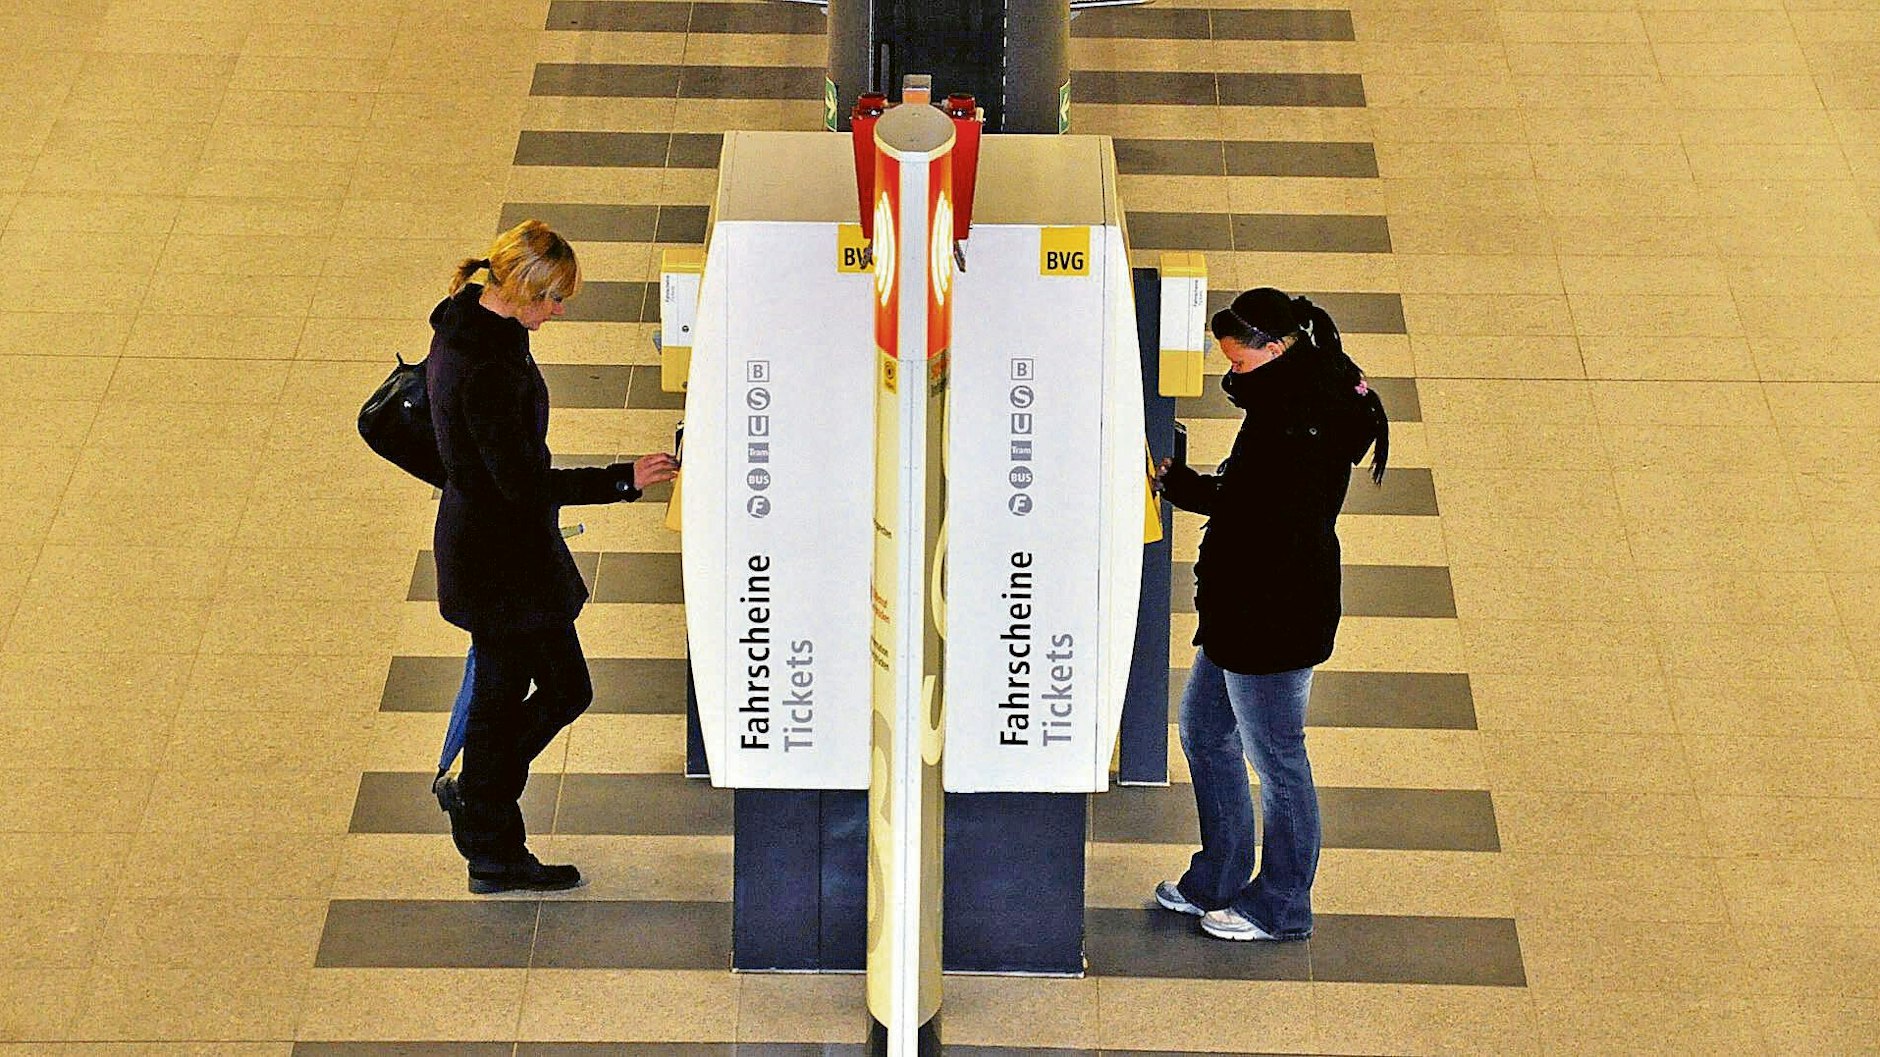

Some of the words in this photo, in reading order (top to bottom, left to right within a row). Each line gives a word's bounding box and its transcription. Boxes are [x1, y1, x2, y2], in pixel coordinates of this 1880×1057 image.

[844, 247, 874, 266] BV
[1047, 251, 1084, 270] BVG
[753, 364, 763, 378] B
[1017, 362, 1027, 376] B
[750, 388, 768, 410] S
[1013, 386, 1031, 408] S
[750, 416, 767, 436] U
[1013, 414, 1030, 434] U
[749, 447, 769, 457] Tram
[1012, 445, 1032, 455] Tram
[749, 474, 770, 485] BUS
[1011, 472, 1032, 483] BUS
[751, 498, 766, 518] F
[1012, 496, 1028, 515] F
[738, 555, 771, 749] Fahrscheine
[998, 551, 1033, 746] Fahrscheine
[782, 639, 814, 753] Tickets
[1041, 633, 1074, 747] Tickets
